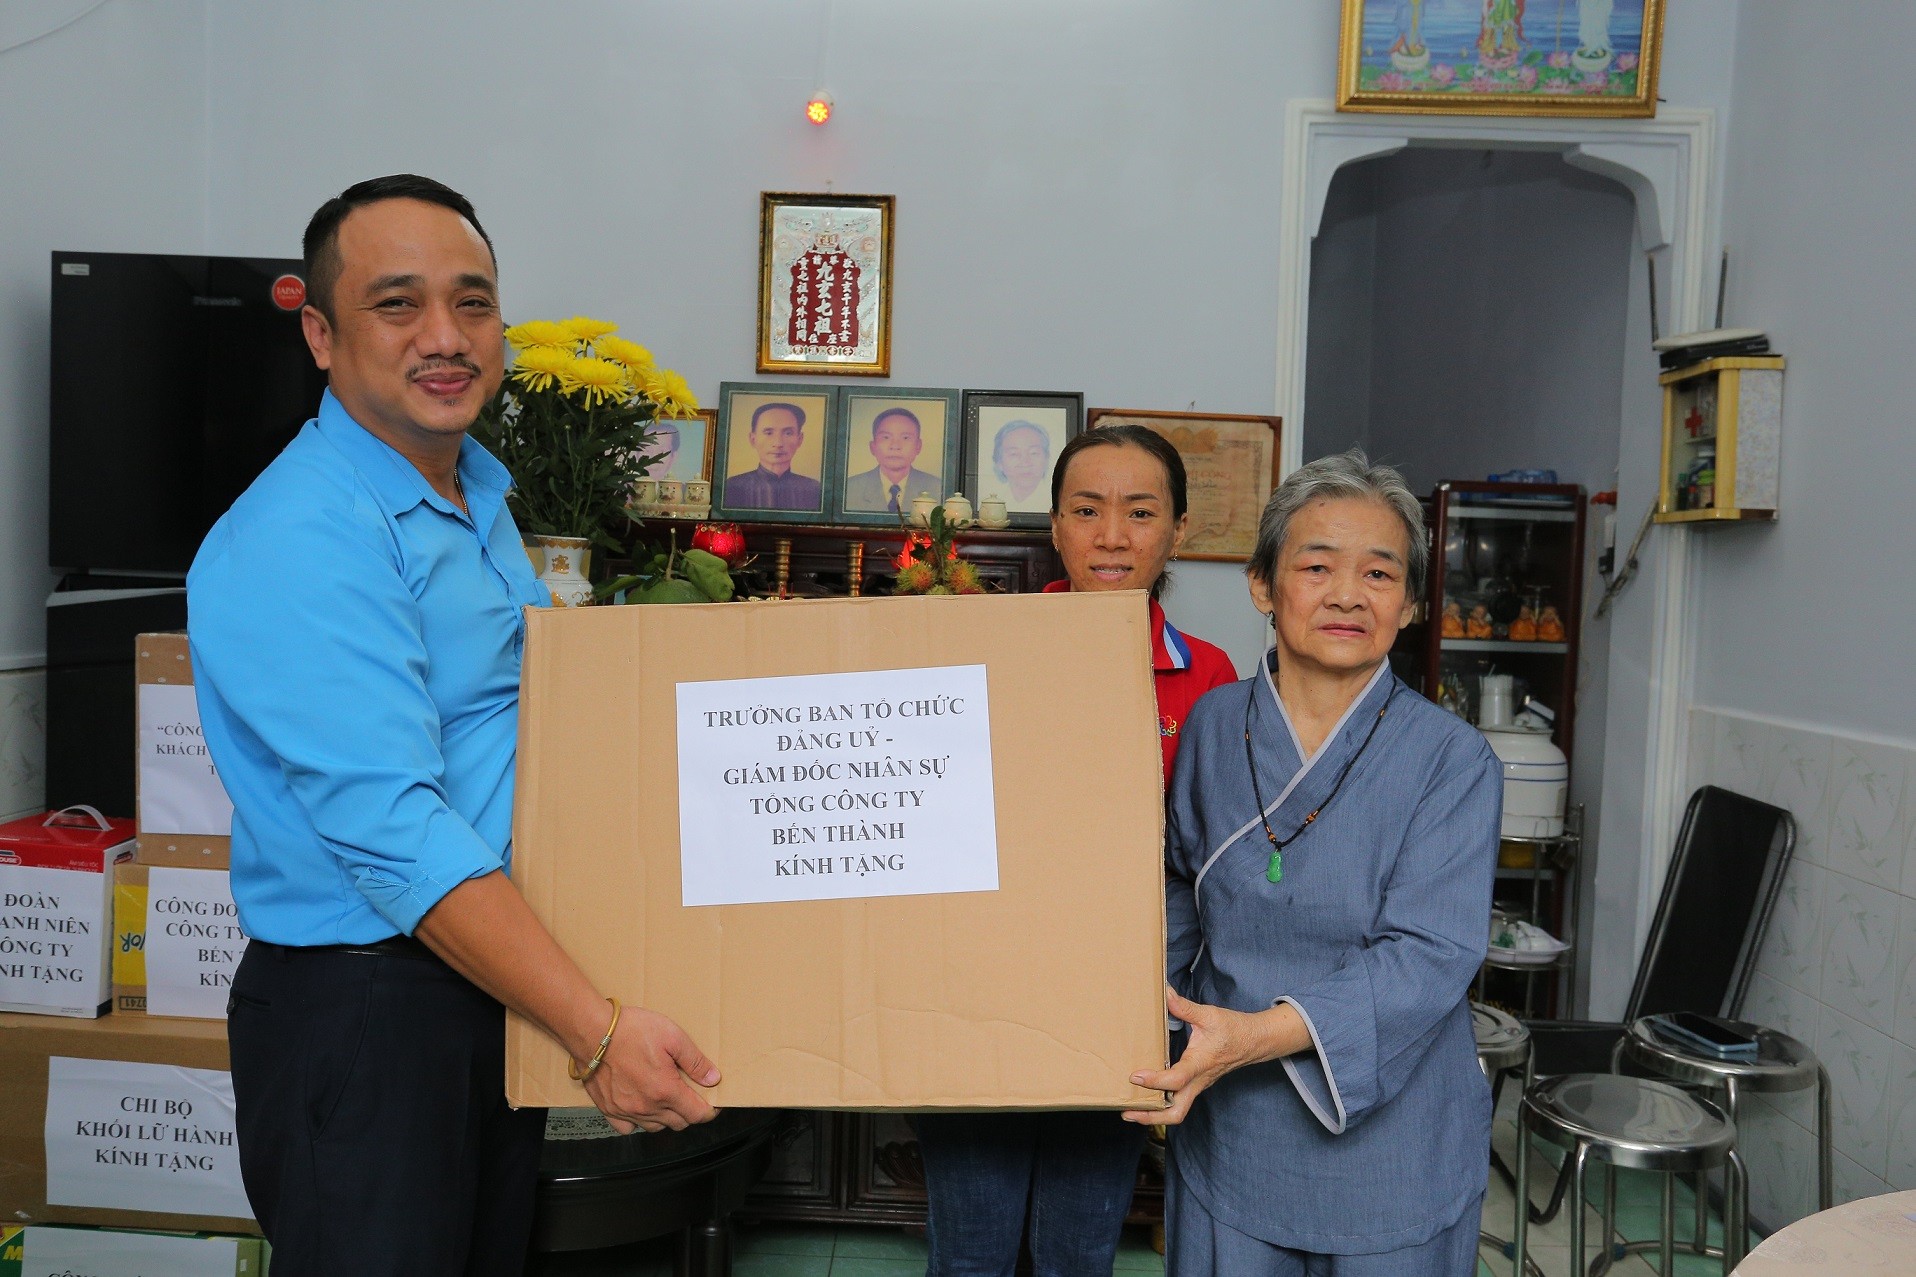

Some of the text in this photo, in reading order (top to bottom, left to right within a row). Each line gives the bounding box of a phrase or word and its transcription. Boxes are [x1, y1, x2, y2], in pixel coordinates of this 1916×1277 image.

[276, 286, 302, 295] JAPAN
[703, 694, 965, 727] TRƯỞNG BAN TỔ CHỨC
[156, 742, 206, 756] KHÁCH
[777, 729, 842, 751] ĐẢNG
[849, 725, 880, 748] UỶ
[723, 755, 949, 785] GIÁM ĐỐC NHÂN SỰ
[750, 789, 925, 815] TỔNG CÔNG TY
[772, 820, 905, 845] BẾN THÀNH
[774, 853, 905, 877] KÍNH TẶNG
[4, 892, 60, 909] ĐOÀN
[155, 896, 207, 916] CÔNG
[44, 916, 90, 934] NIÊN
[166, 919, 218, 939] CÔNG
[0, 936, 73, 957] ÔNG TY
[30, 965, 83, 984] TẶNG
[120, 1096, 192, 1120] CHI BỘ
[76, 1118, 233, 1146] KHỐI LỮ HÀNH
[95, 1146, 213, 1173] KÍNH TẶNG
